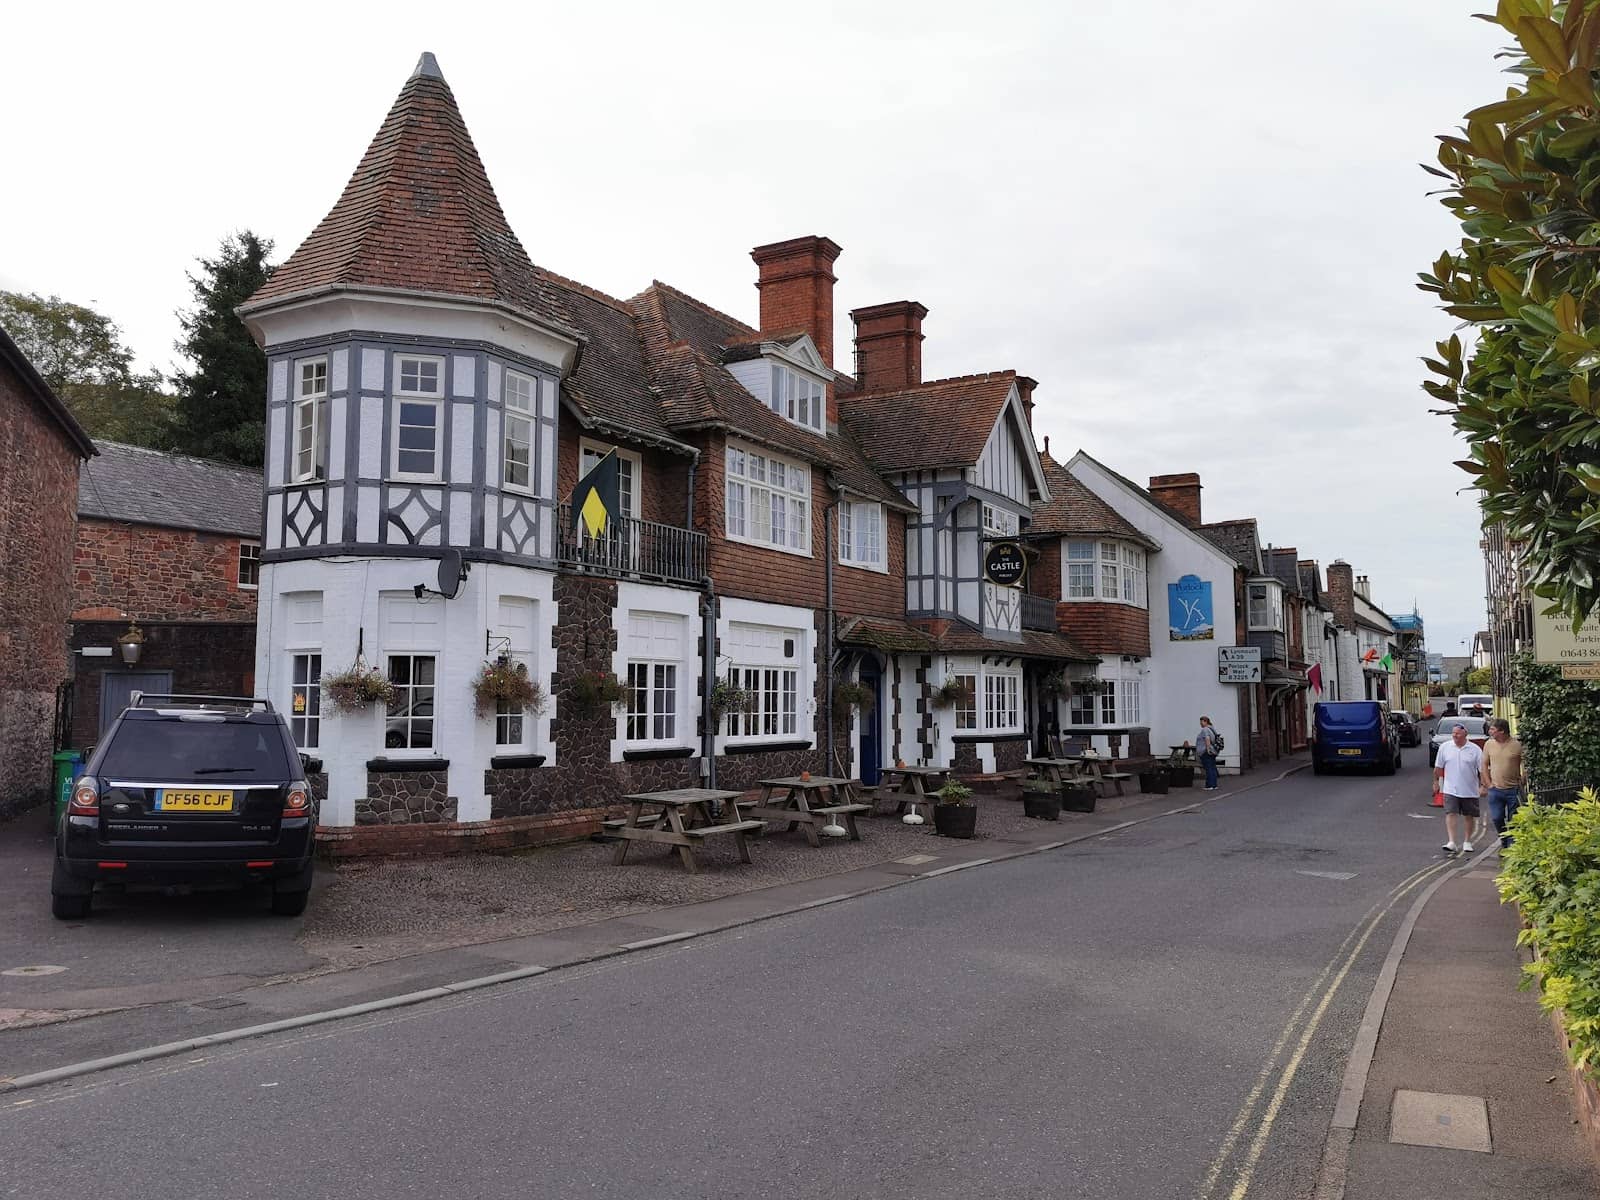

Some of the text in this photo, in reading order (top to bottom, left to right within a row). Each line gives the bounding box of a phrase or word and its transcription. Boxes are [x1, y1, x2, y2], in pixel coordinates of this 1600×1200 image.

[991, 562, 1021, 571] CASTLE
[1560, 649, 1587, 657] 01643
[165, 794, 230, 805] CF56 CJF
